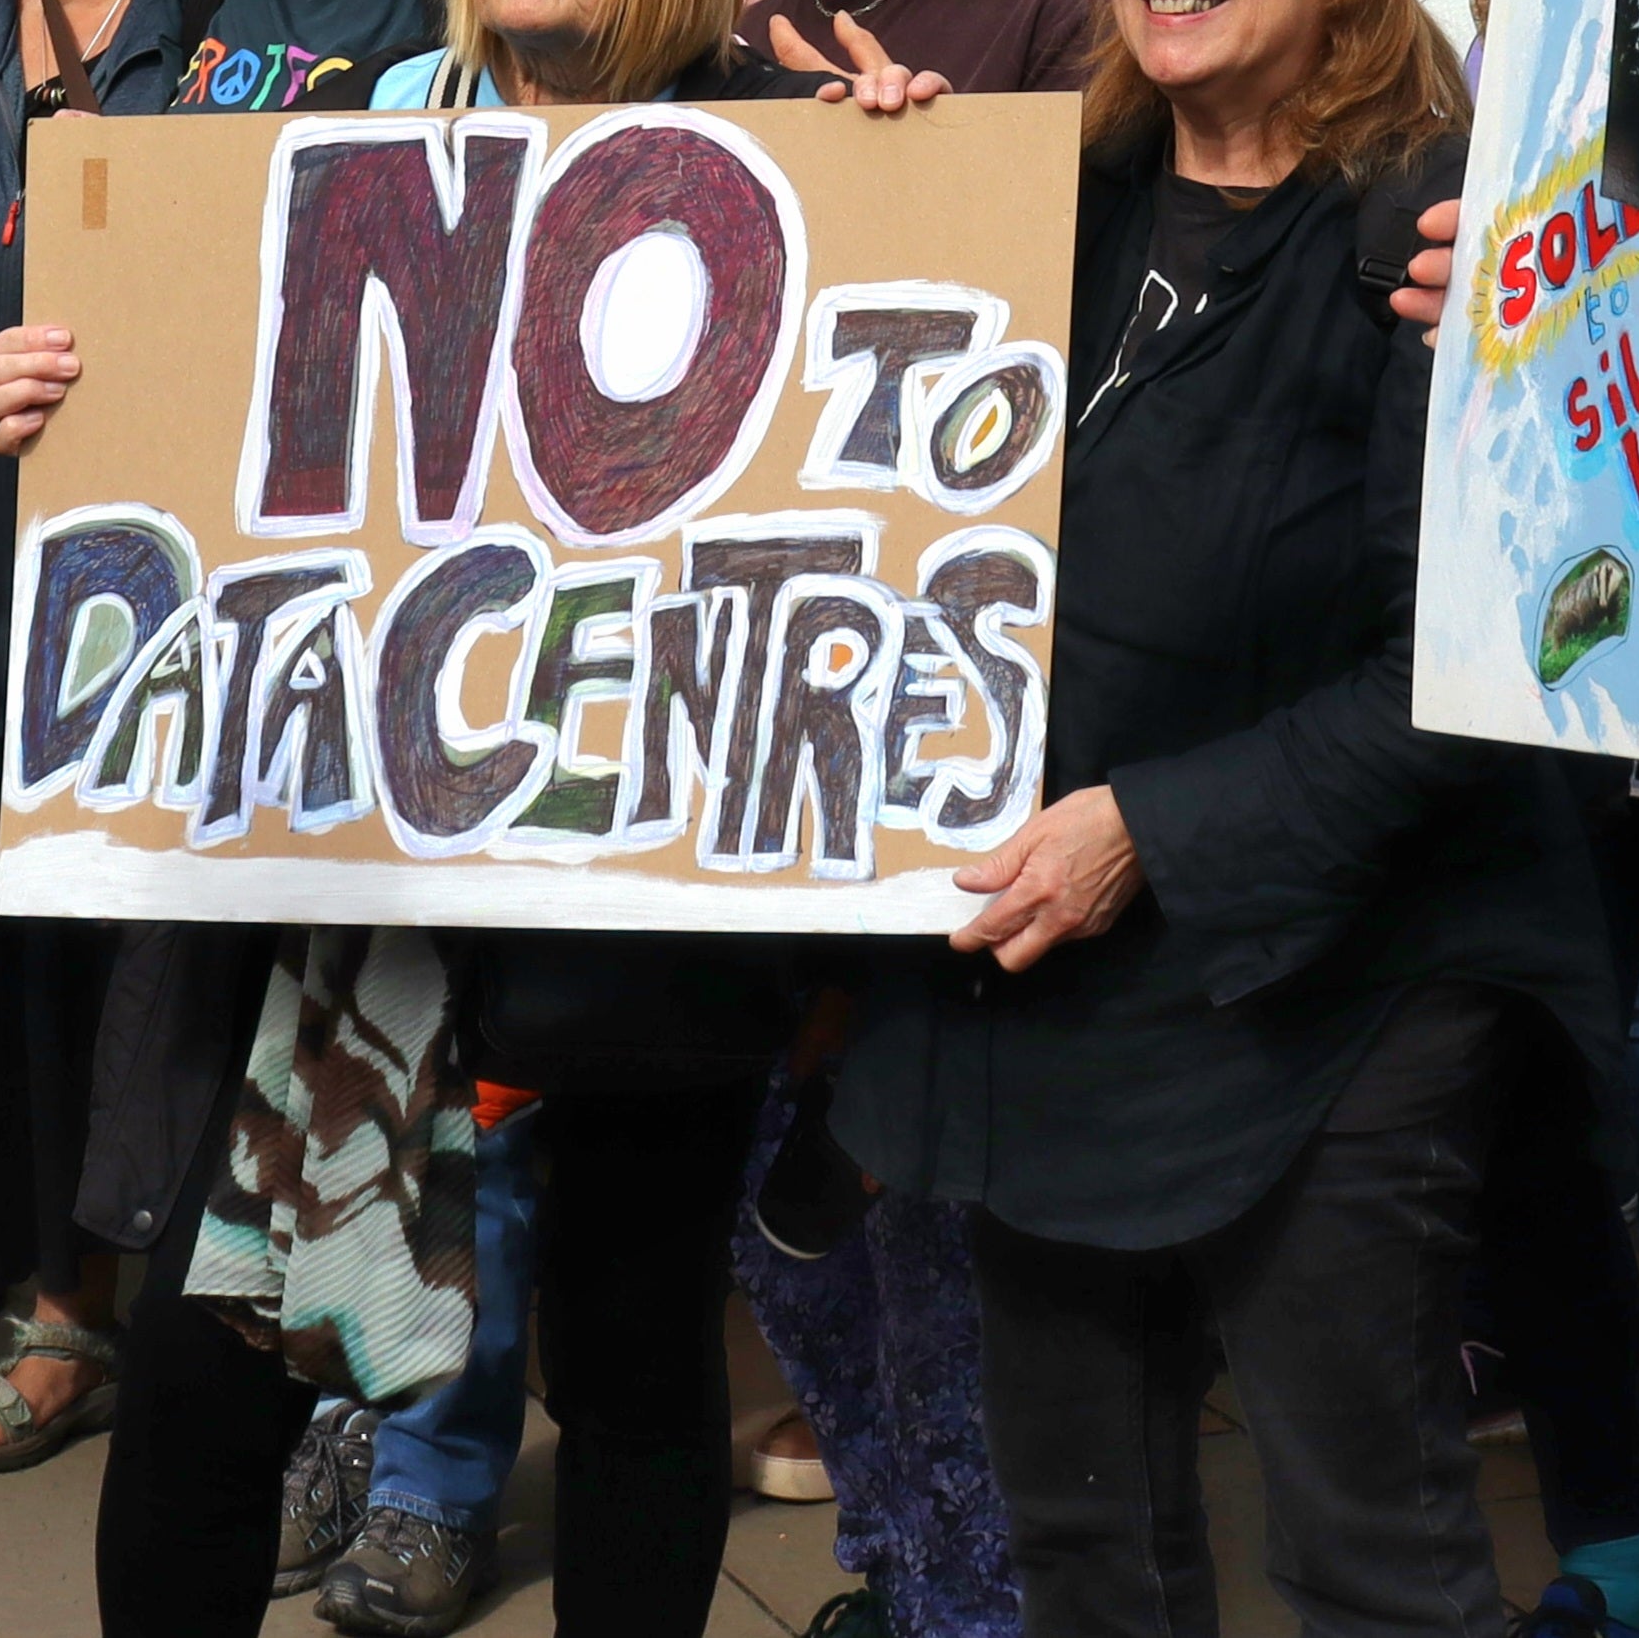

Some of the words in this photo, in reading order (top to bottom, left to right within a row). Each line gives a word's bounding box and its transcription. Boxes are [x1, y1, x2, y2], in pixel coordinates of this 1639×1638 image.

[235, 105, 806, 546] NO
[800, 282, 1063, 514] TO
[4, 503, 373, 846] DATA
[369, 512, 1058, 879] CENTRES
